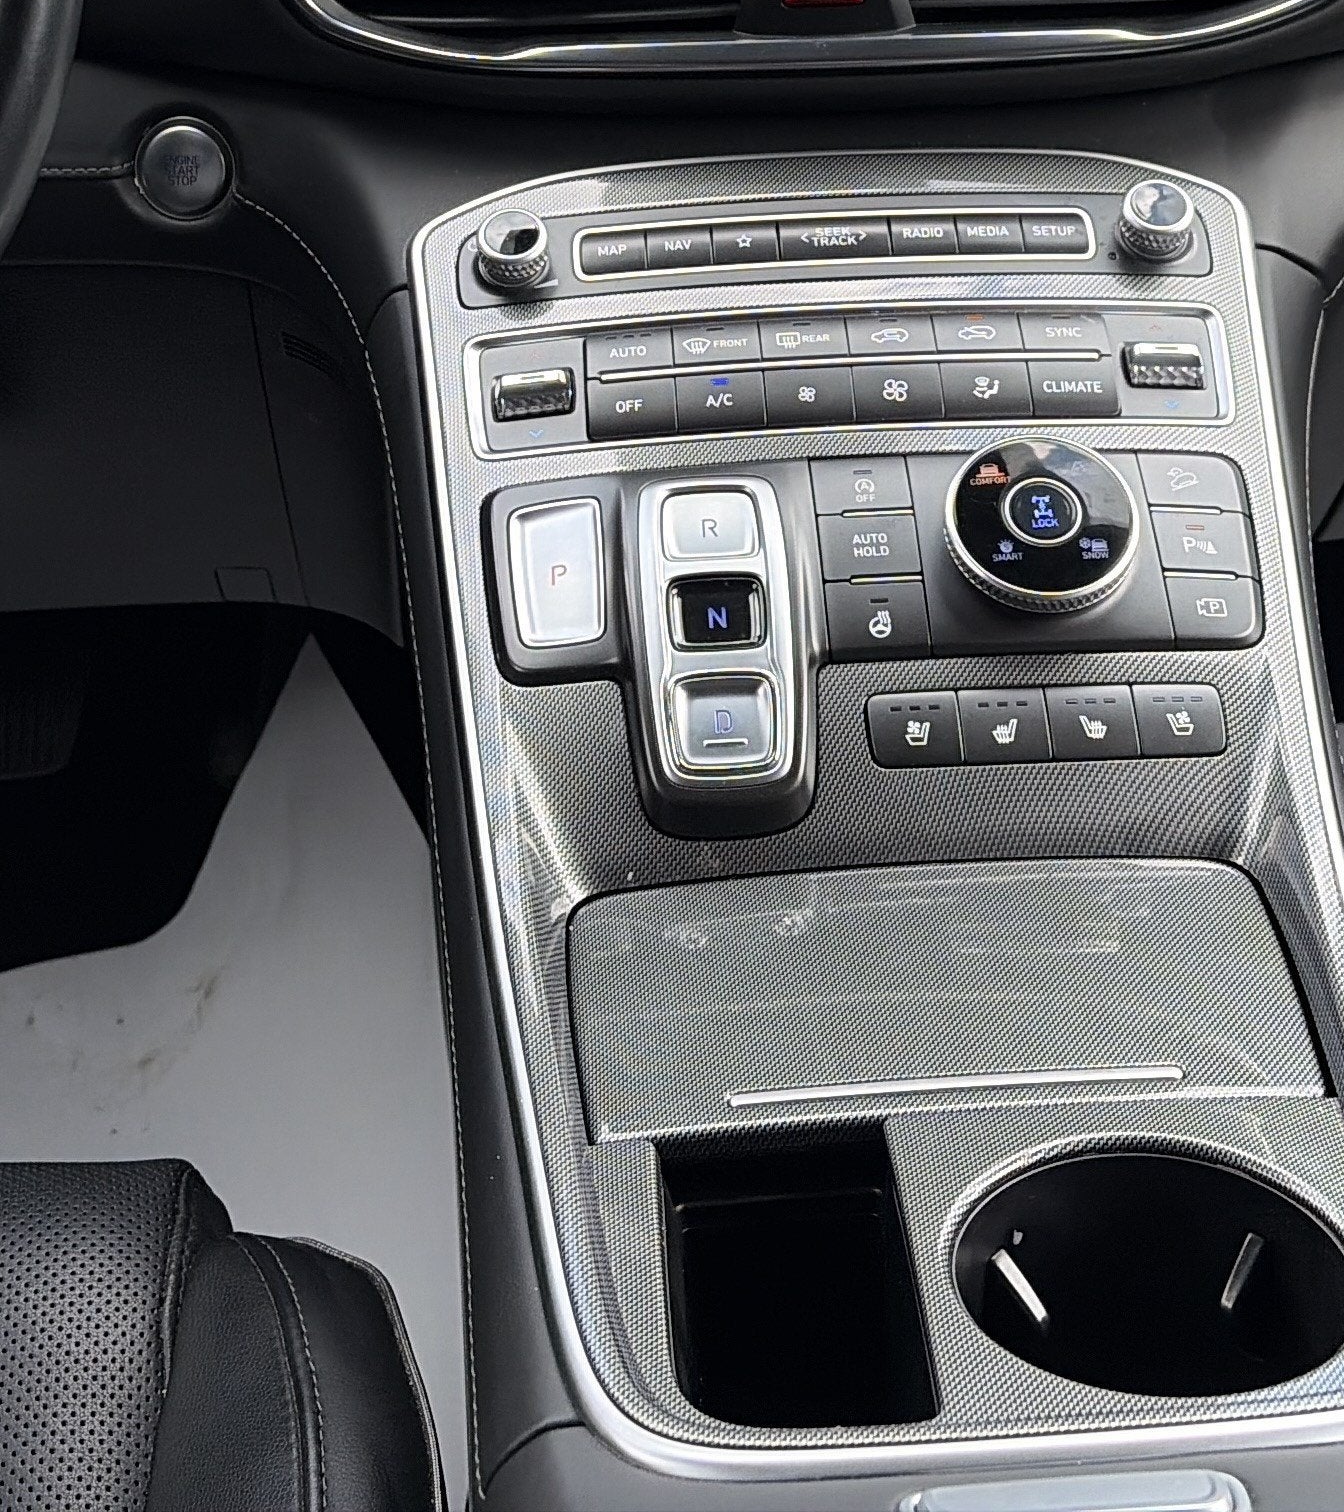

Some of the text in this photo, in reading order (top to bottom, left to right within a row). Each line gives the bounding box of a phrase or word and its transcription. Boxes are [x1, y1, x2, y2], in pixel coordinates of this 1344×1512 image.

[167, 176, 197, 186] STOP
[815, 226, 851, 236] SEEK
[902, 226, 944, 239] RADIO
[966, 226, 1010, 237] MEDIA
[1031, 225, 1076, 237] SETUP
[664, 238, 692, 251] NAV
[811, 235, 858, 247] TRACK
[597, 244, 627, 257] MAP
[801, 333, 830, 344] REAR
[1045, 327, 1083, 338] SYNC
[712, 338, 748, 349] FRONT
[609, 345, 647, 359] AUTO
[1042, 380, 1103, 394] CLIMATE
[615, 399, 643, 414] OFF
[705, 393, 734, 409] A/C
[970, 476, 1011, 487] COMFORT
[855, 494, 876, 503] OFF
[701, 518, 718, 538] R
[1031, 519, 1060, 529] LOCK
[852, 533, 888, 544] AUTO
[1182, 536, 1196, 553] P
[853, 546, 890, 558] HOLD
[992, 552, 1024, 563] SMART
[1081, 551, 1109, 560] SNOW
[551, 564, 568, 586] P
[1209, 601, 1220, 613] P
[707, 607, 728, 629] N
[713, 709, 735, 735] D
